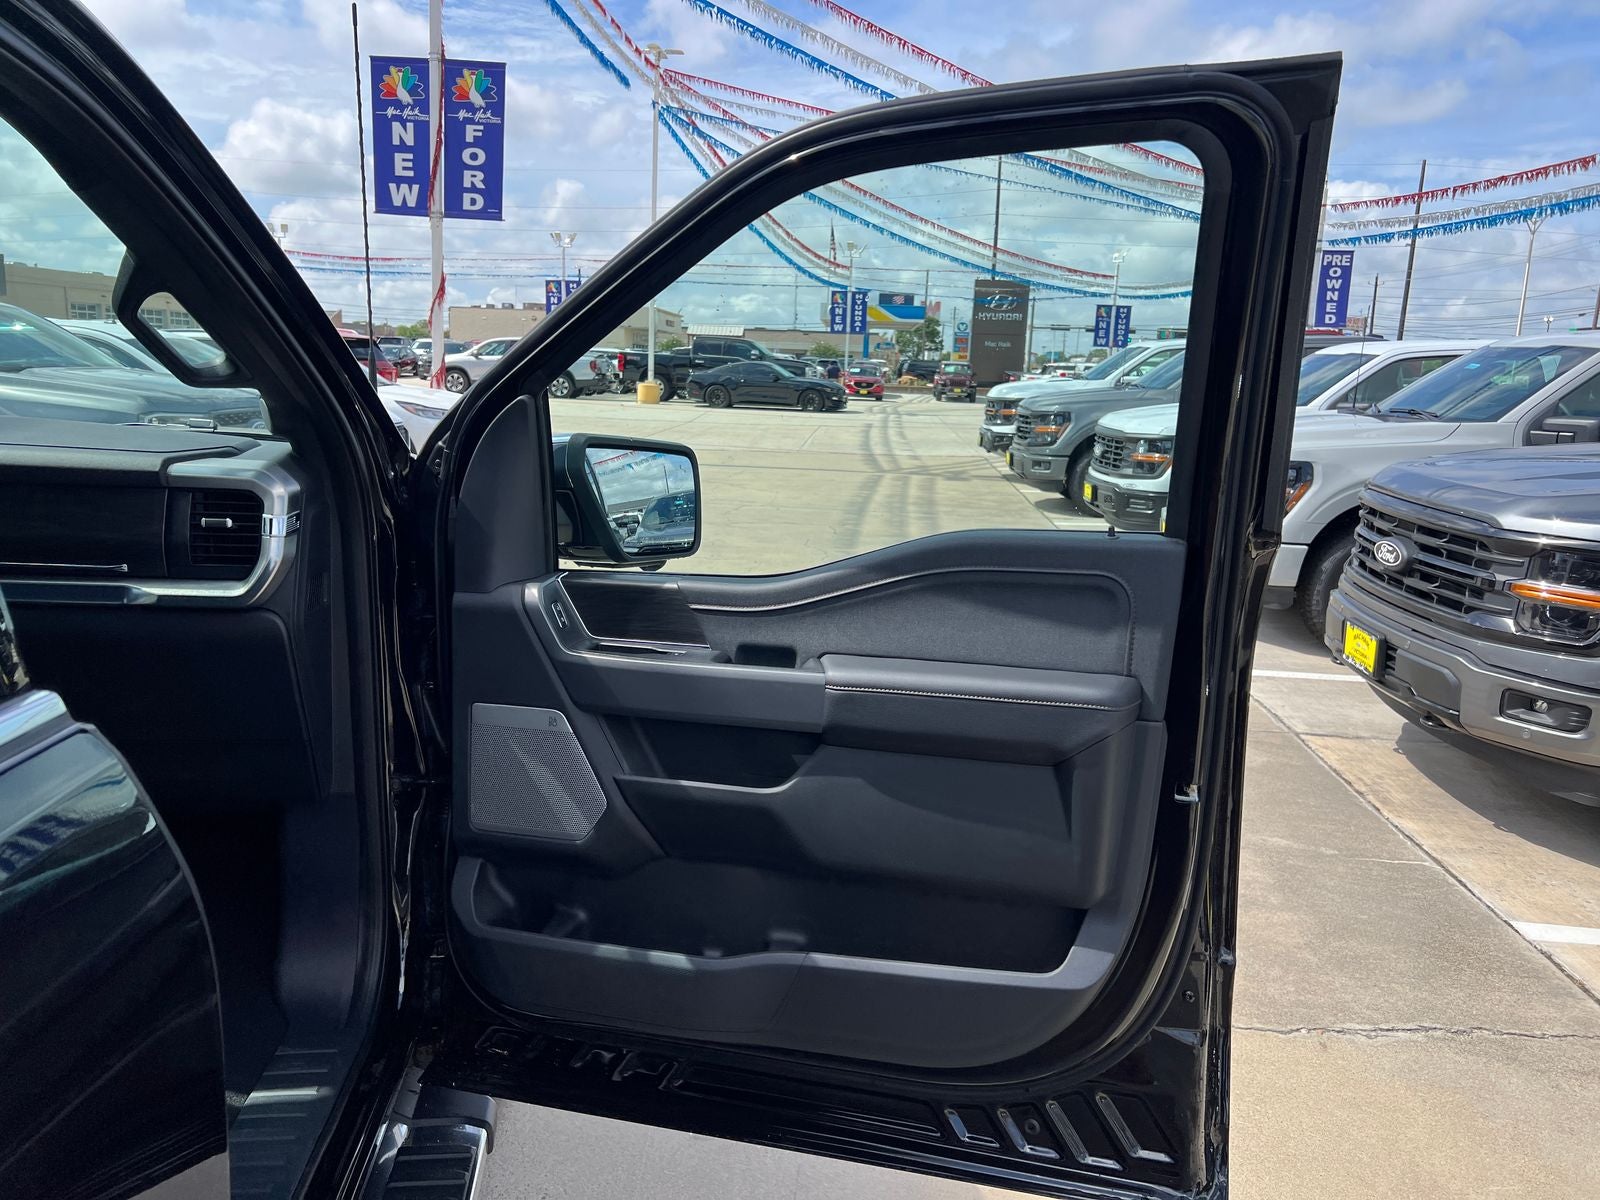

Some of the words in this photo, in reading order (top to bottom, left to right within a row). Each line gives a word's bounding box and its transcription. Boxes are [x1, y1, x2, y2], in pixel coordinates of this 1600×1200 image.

[376, 106, 402, 119] Mac
[388, 121, 420, 208] NEW
[461, 124, 487, 211] FORD
[1323, 254, 1351, 266] PRE
[1324, 267, 1342, 324] OWNED
[833, 307, 844, 332] NEW
[853, 293, 864, 332] HYUNDAI
[978, 312, 1023, 321] HYUNDAI
[1096, 321, 1107, 346] NEW
[1116, 307, 1128, 346] HYUNDAI
[1379, 543, 1397, 563] Ford
